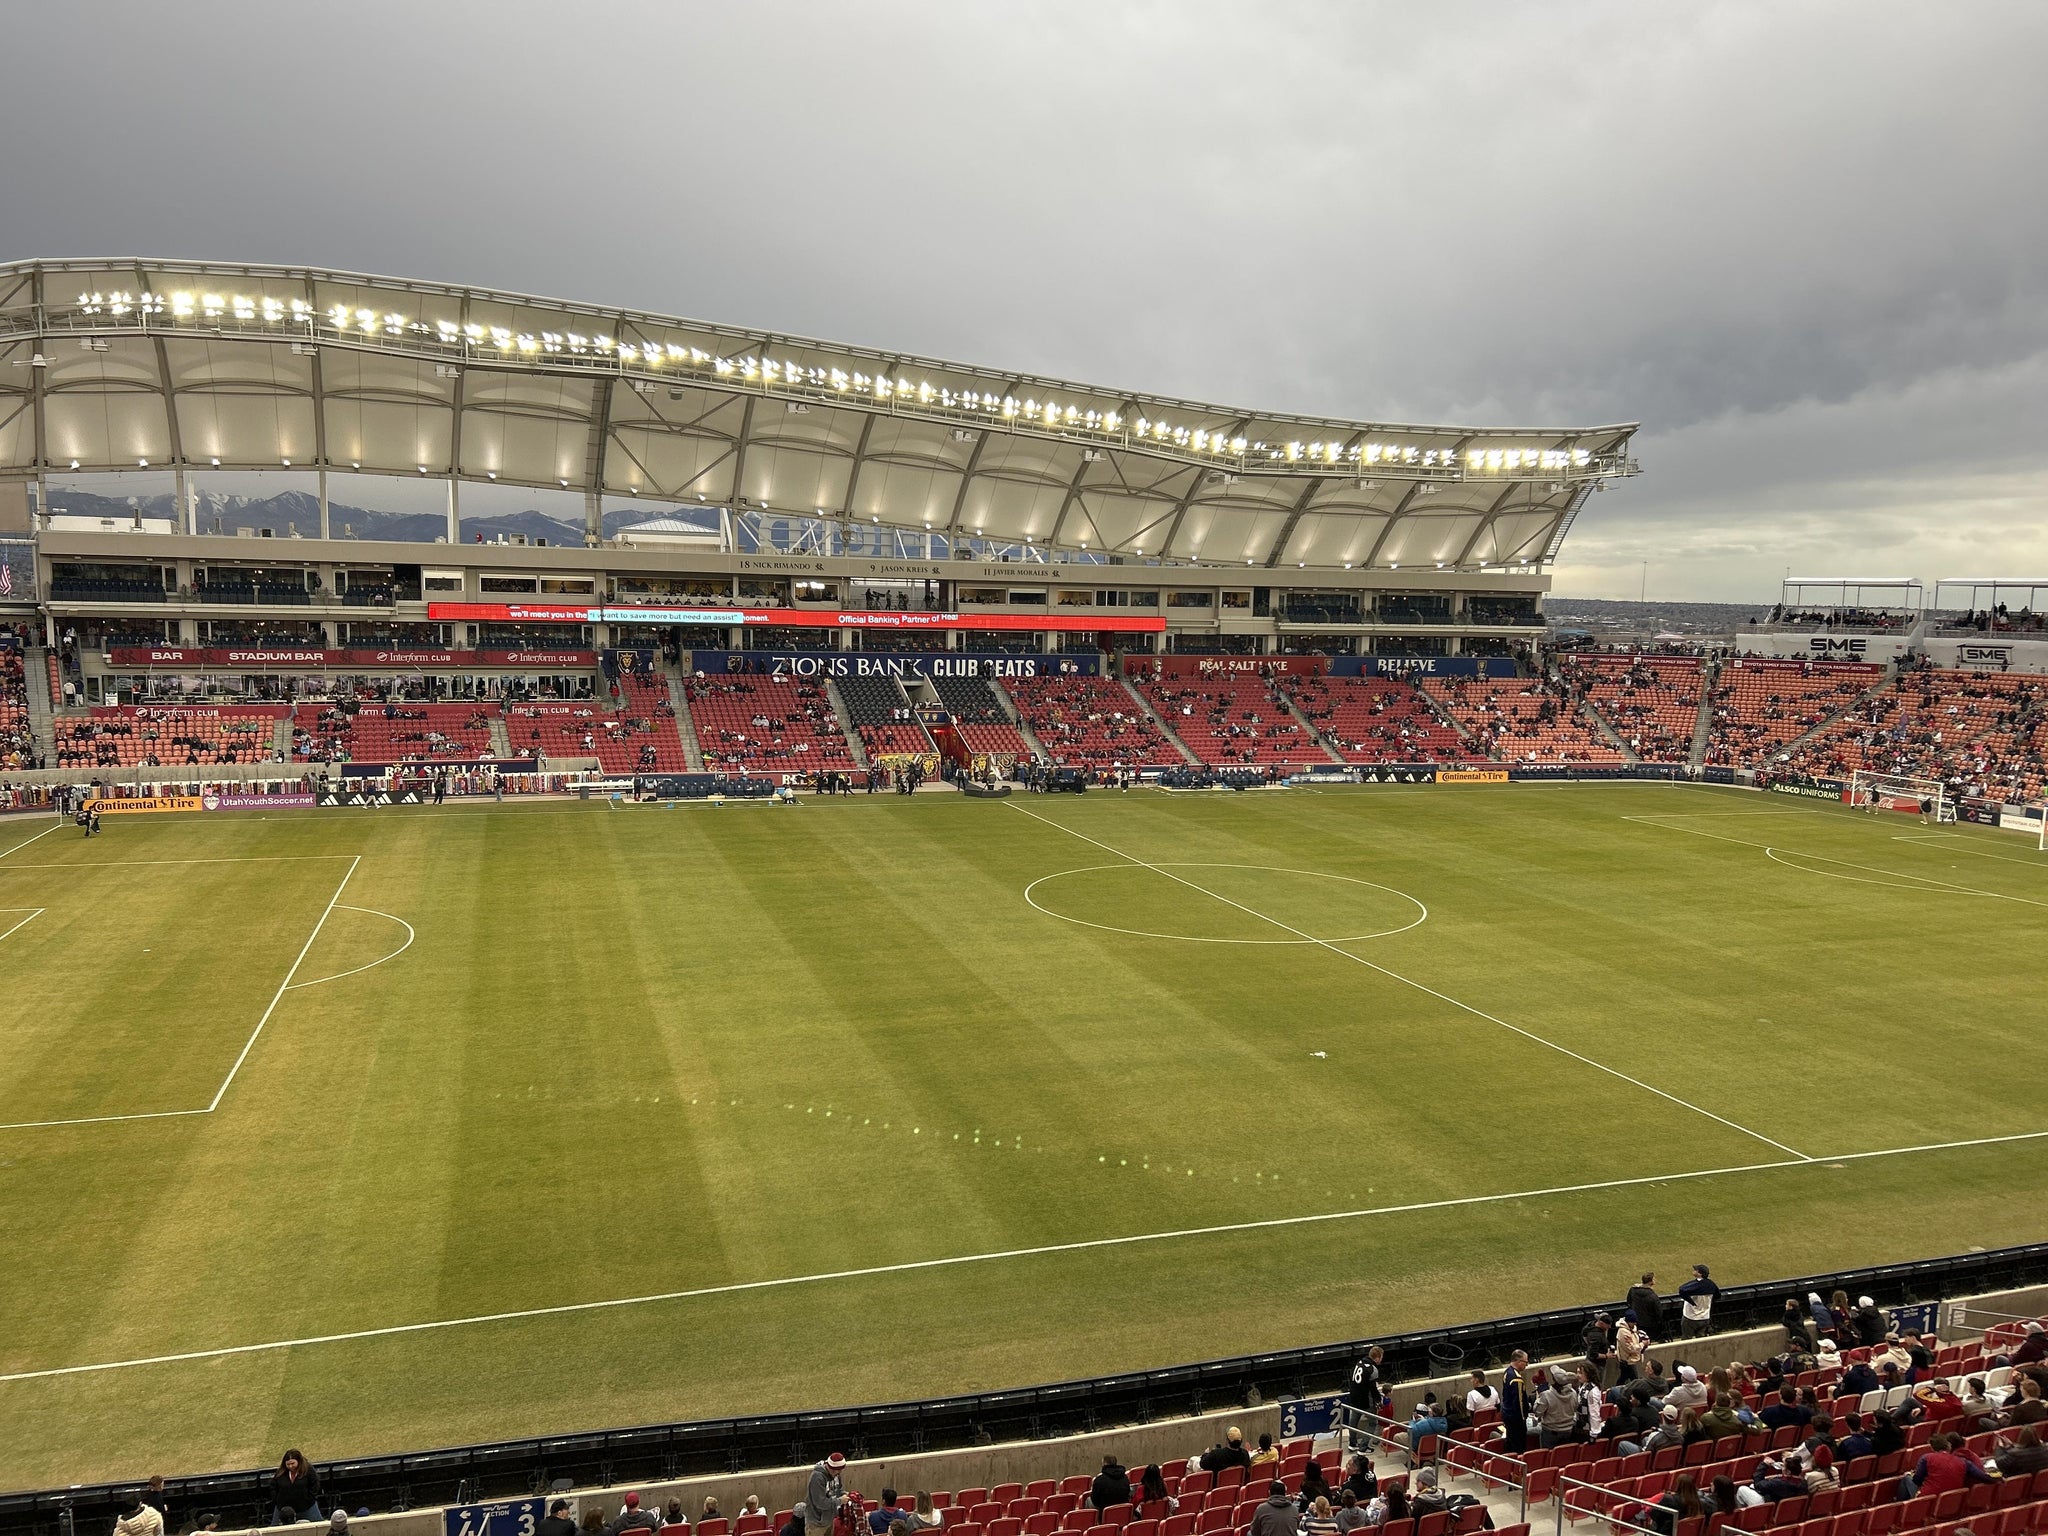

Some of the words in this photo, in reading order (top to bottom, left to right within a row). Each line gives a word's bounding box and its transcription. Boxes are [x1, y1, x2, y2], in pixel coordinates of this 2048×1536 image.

[753, 561, 772, 569] NICK
[774, 562, 810, 570] RIMANDO
[993, 569, 1015, 577] JAVIER
[838, 615, 866, 623] Official
[868, 616, 899, 625] Banking
[901, 614, 930, 623] Partner
[1811, 638, 1866, 651] SME
[152, 652, 182, 660] BAR
[229, 652, 292, 661] STADIUM
[295, 653, 323, 661] BAR
[390, 652, 429, 662] Interform
[520, 652, 558, 662] Interform
[1967, 649, 2006, 659] SME
[772, 657, 848, 676] ZIONS
[856, 658, 924, 677] BANK
[933, 659, 978, 676] CLUB
[1228, 661, 1256, 670] SALT
[1442, 773, 1481, 781] Continental
[1774, 784, 1800, 794] ALSCO
[1801, 788, 1840, 800] UNIFORMS
[94, 799, 157, 812] Continental
[169, 798, 194, 808] Tire
[223, 796, 314, 806] UtahYouthSoccer.net
[1923, 1315, 1930, 1333] 1
[1352, 1365, 1363, 1384] 18
[1329, 1408, 1341, 1430] 2
[1283, 1415, 1297, 1437] 3
[518, 1514, 535, 1536] 3
